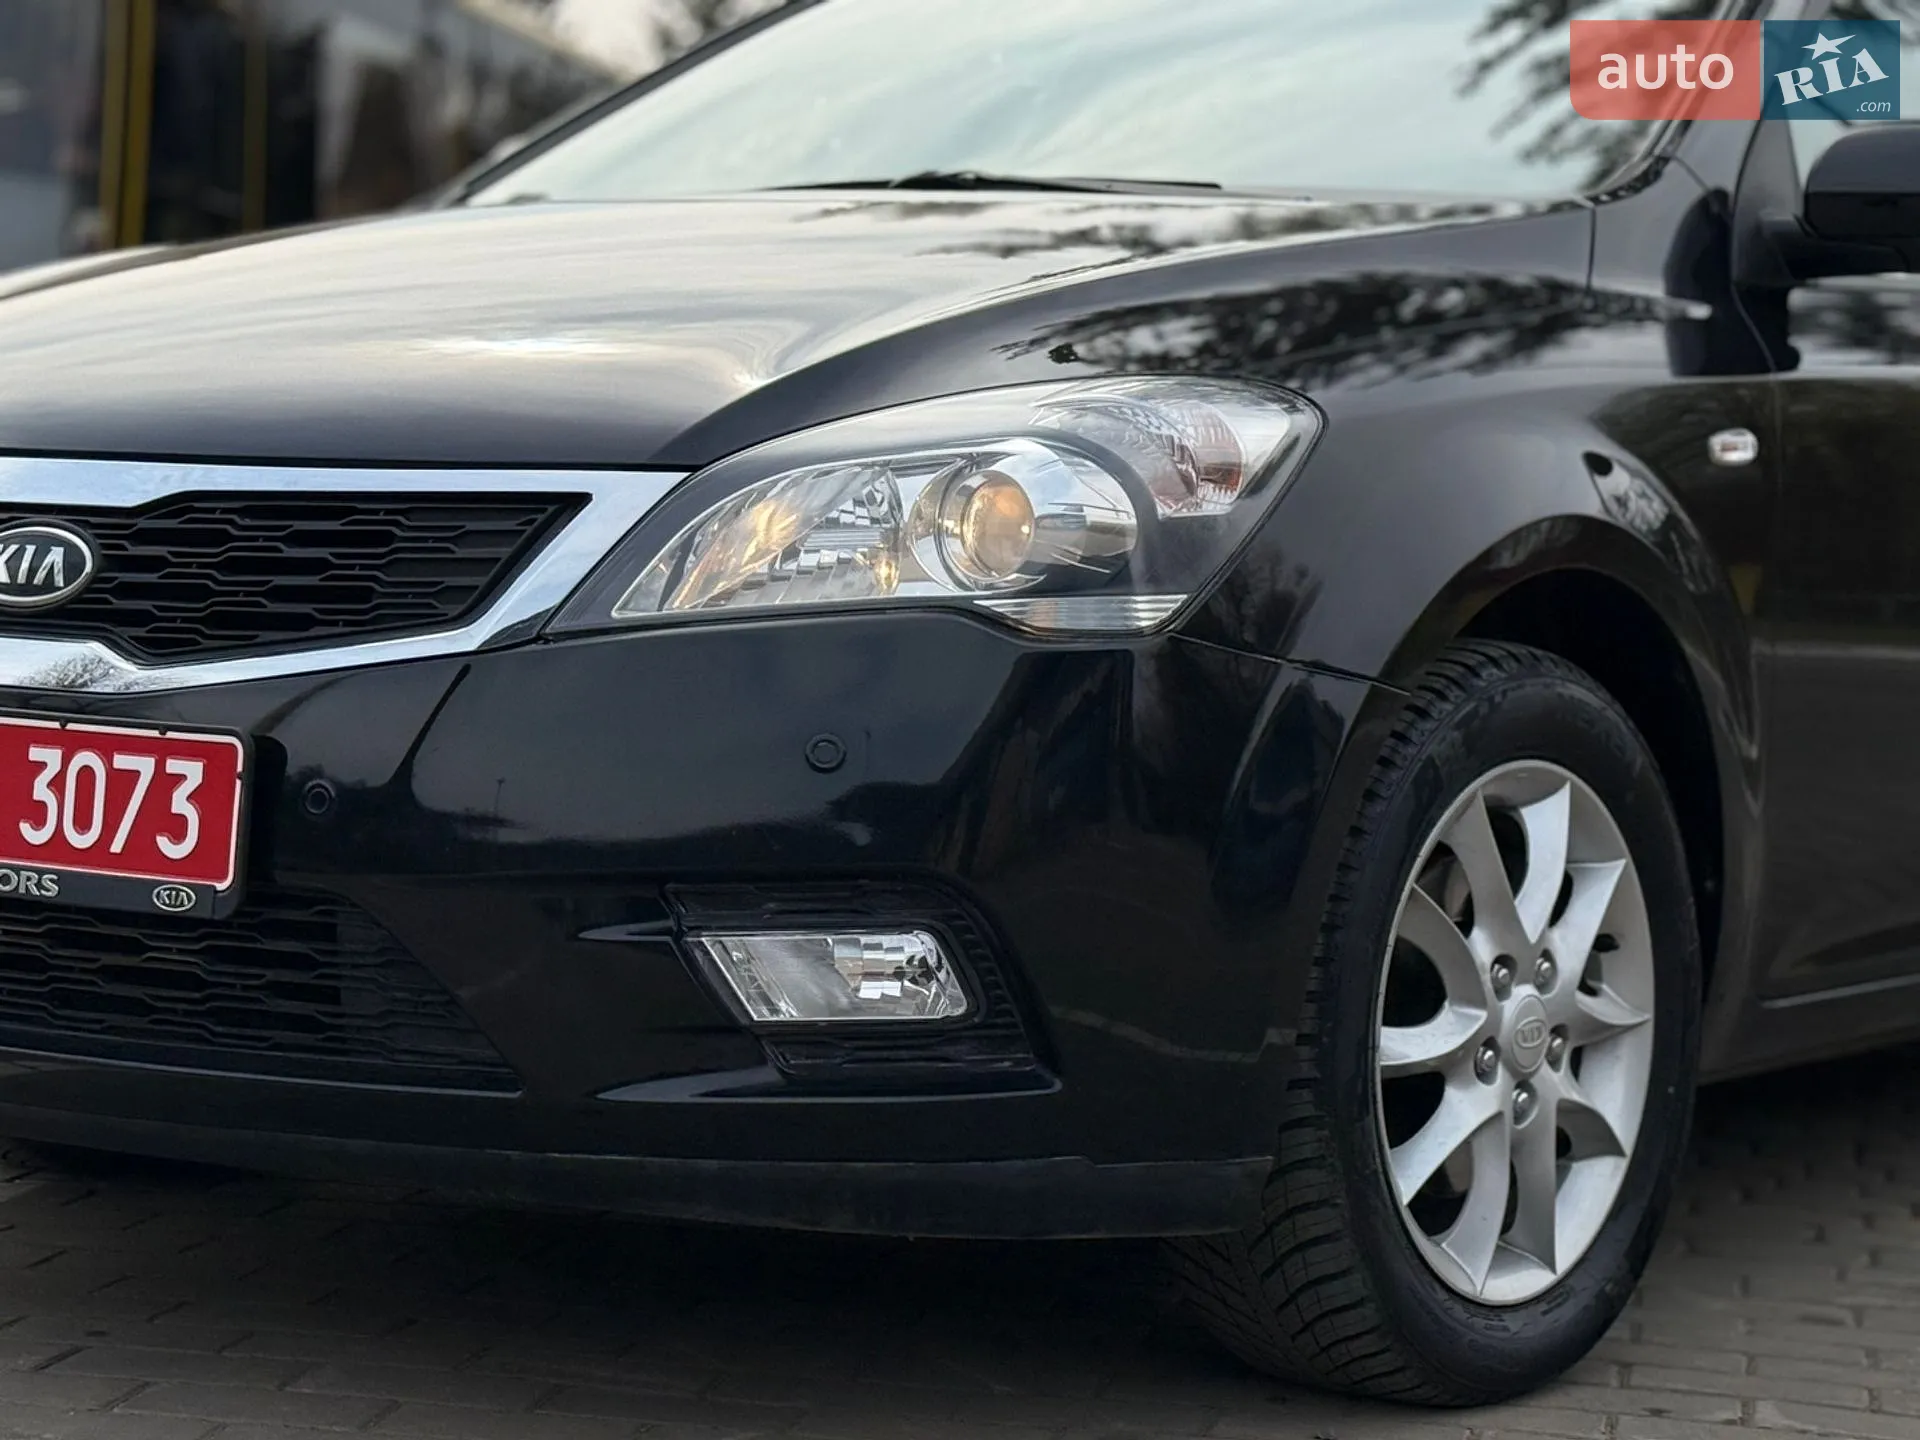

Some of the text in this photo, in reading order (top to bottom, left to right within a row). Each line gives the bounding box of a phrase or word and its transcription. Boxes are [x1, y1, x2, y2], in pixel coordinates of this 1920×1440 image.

[0, 544, 64, 587] KIA
[19, 745, 205, 860] 3073
[0, 868, 59, 897] ORS
[159, 889, 188, 906] KIA
